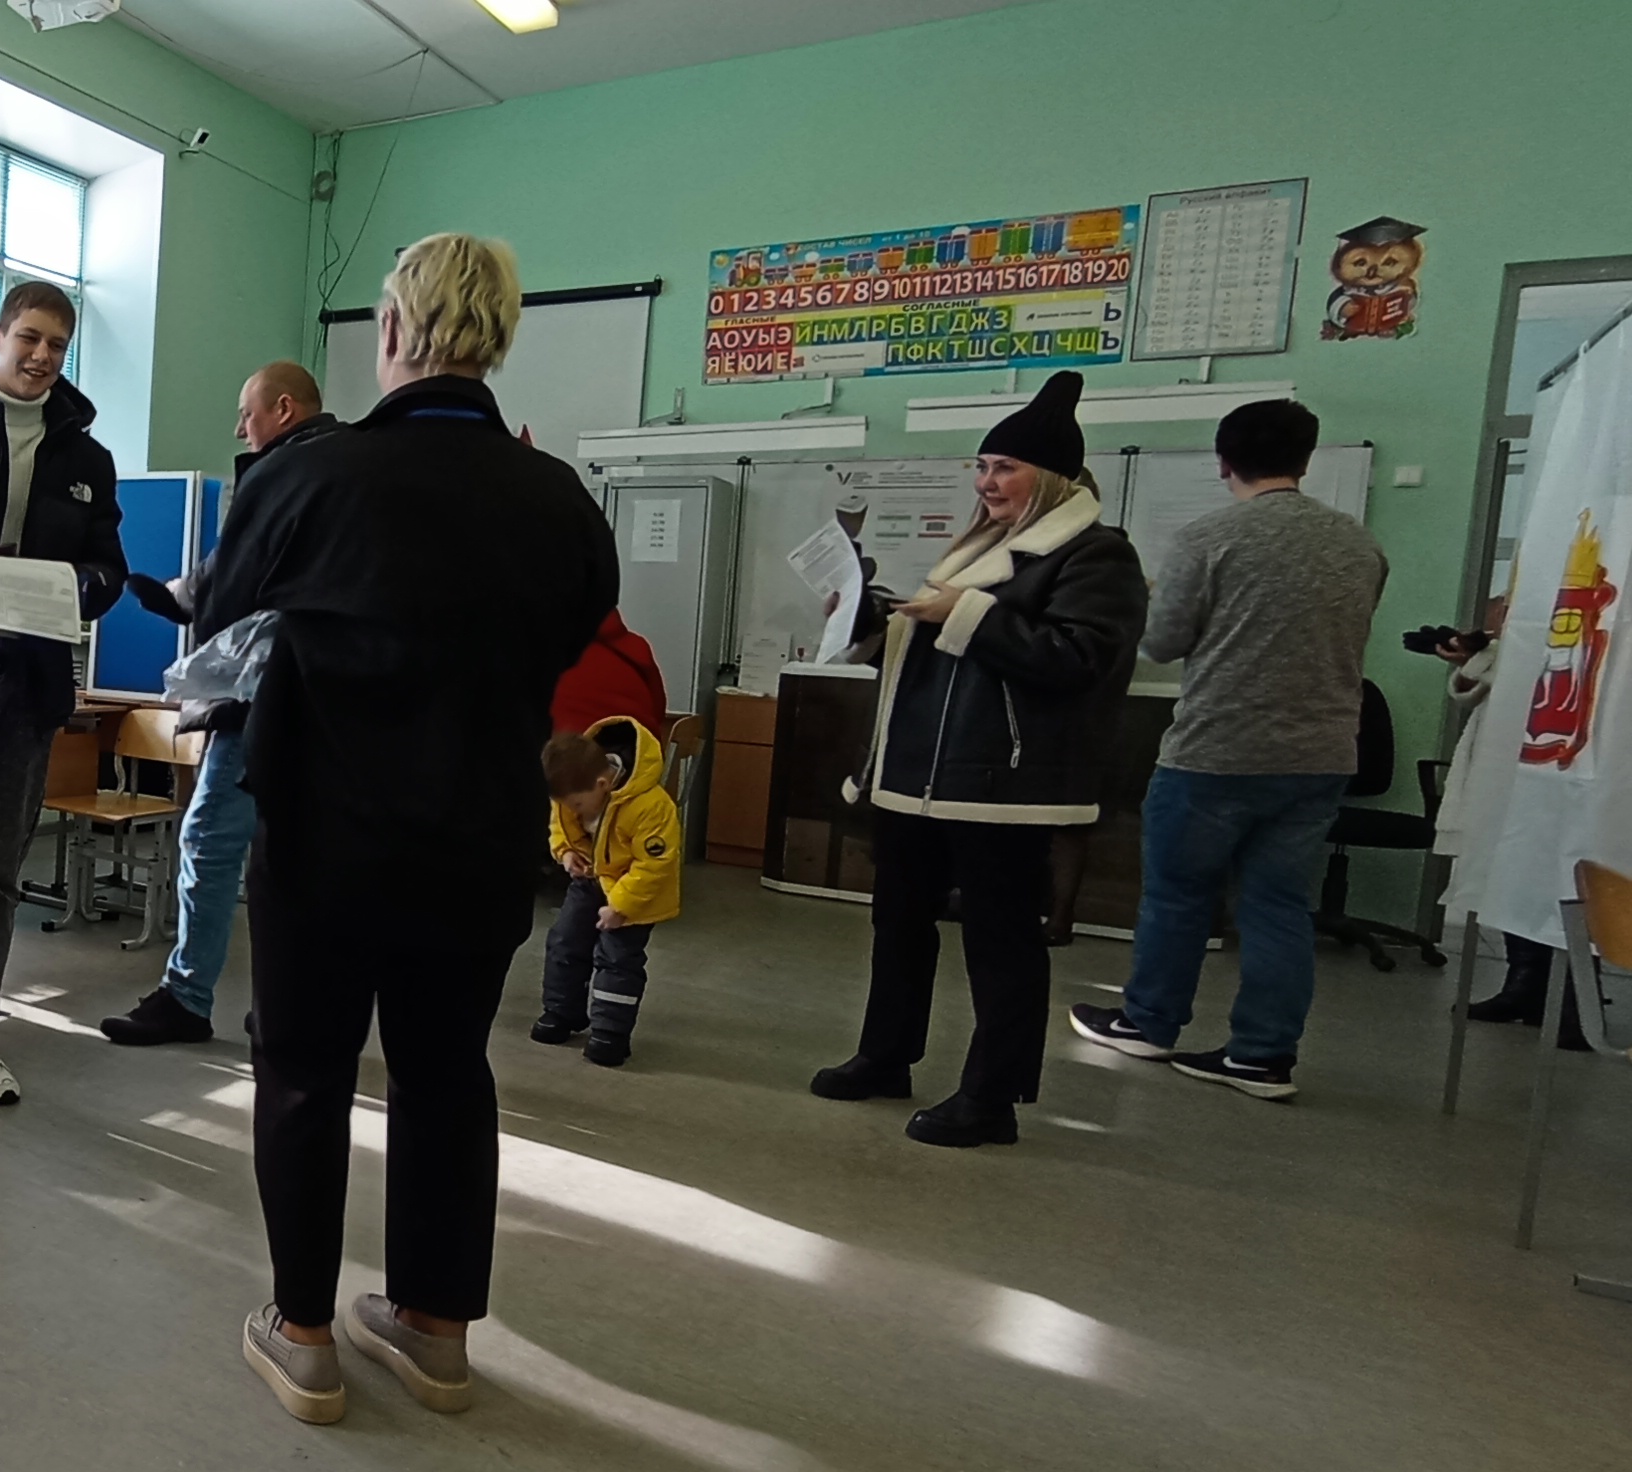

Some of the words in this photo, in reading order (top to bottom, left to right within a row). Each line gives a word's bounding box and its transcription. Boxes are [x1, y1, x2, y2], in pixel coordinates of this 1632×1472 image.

[710, 296, 723, 314] 0
[730, 293, 740, 312] 1
[744, 292, 758, 311] 2
[762, 290, 776, 310] 3
[779, 289, 795, 308] 4
[798, 286, 813, 307] 5
[817, 284, 832, 305] 6
[836, 283, 851, 304] 7
[853, 281, 868, 301] 8
[873, 280, 889, 300] 9
[892, 278, 911, 299] 10
[912, 276, 930, 297] 11
[933, 275, 952, 296] 12
[953, 273, 972, 294] 13
[973, 271, 993, 292] 14
[995, 269, 1015, 290] 15
[1017, 266, 1038, 288] 16
[1039, 264, 1061, 286] 17
[1062, 262, 1083, 284] 18
[1084, 260, 1106, 283] 19
[1106, 257, 1130, 281] 20
[902, 298, 980, 312] СОГЛАСНЫЕ
[724, 316, 777, 326] ГЛАСНЫЕ
